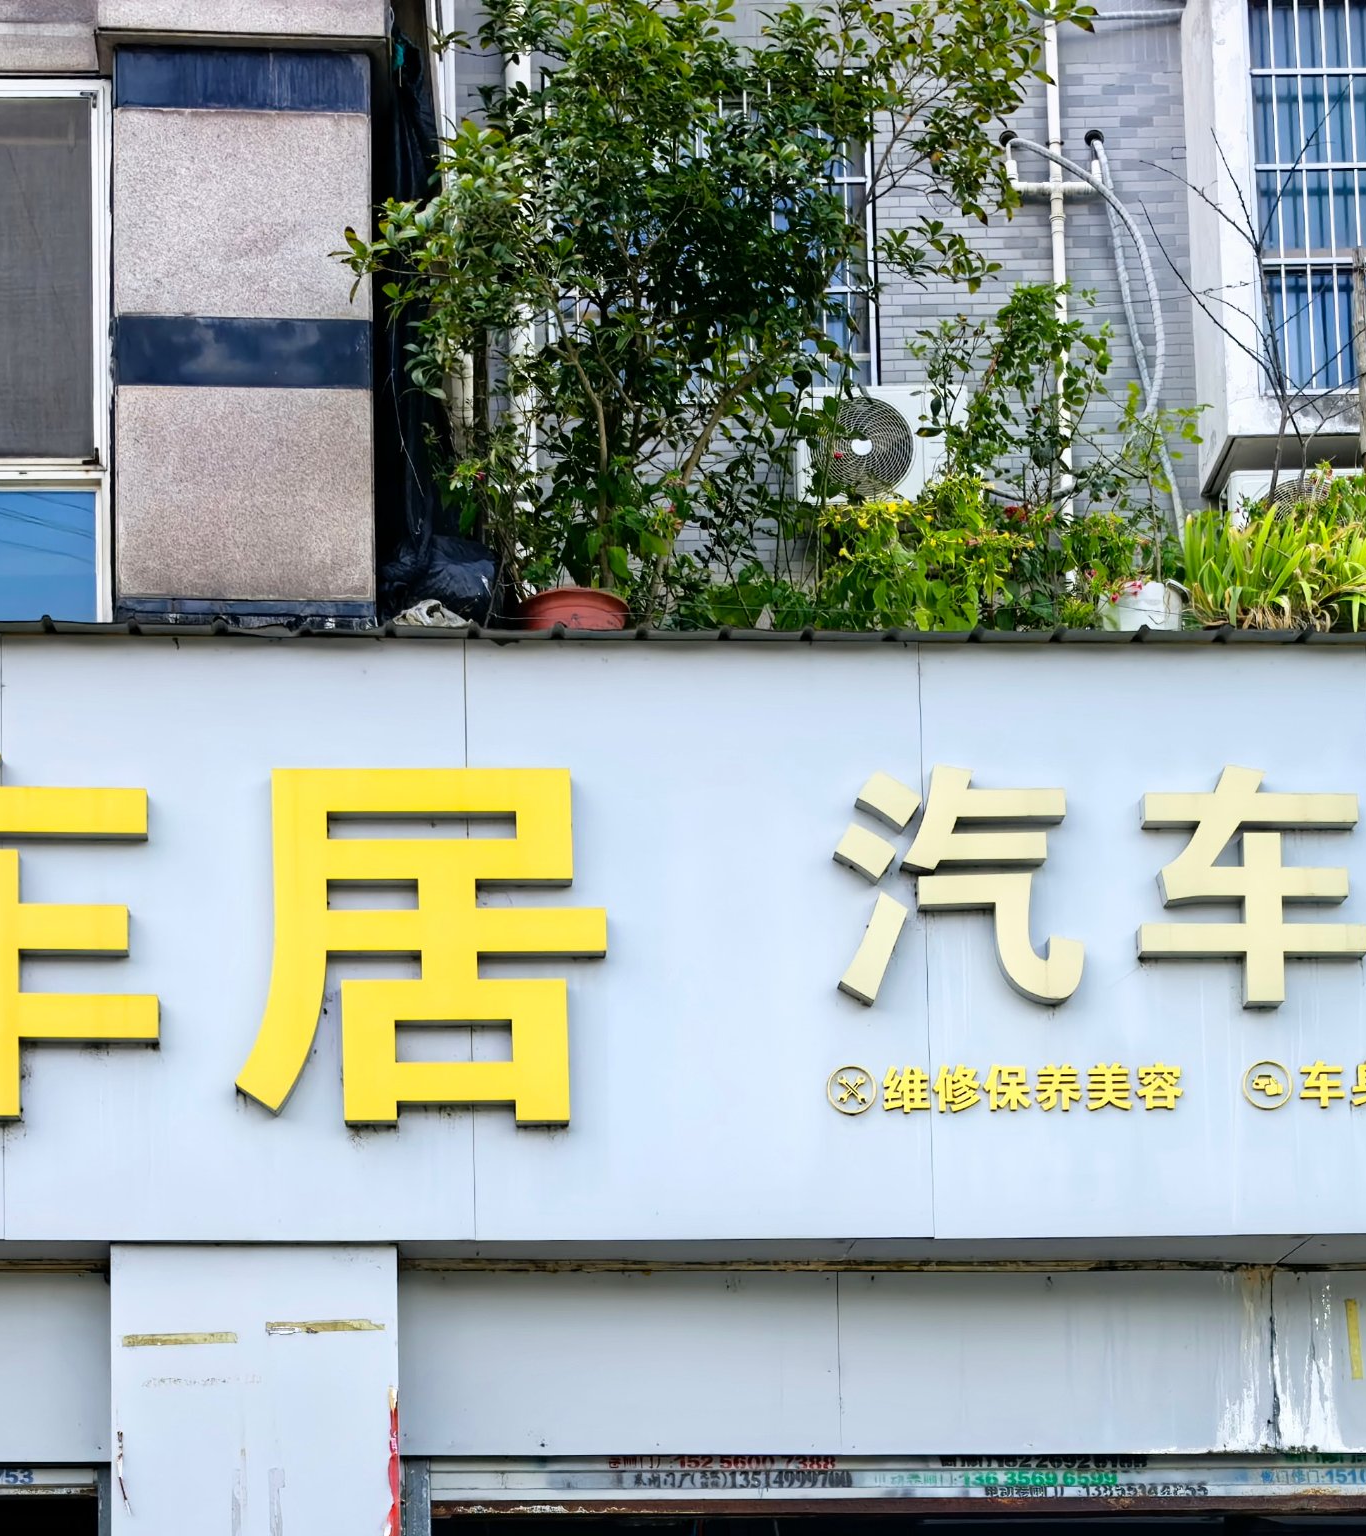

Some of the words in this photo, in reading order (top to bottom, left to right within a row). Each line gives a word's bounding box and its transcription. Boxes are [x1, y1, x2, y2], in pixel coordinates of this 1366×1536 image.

[882, 1062, 1184, 1113] 维修保养美容
